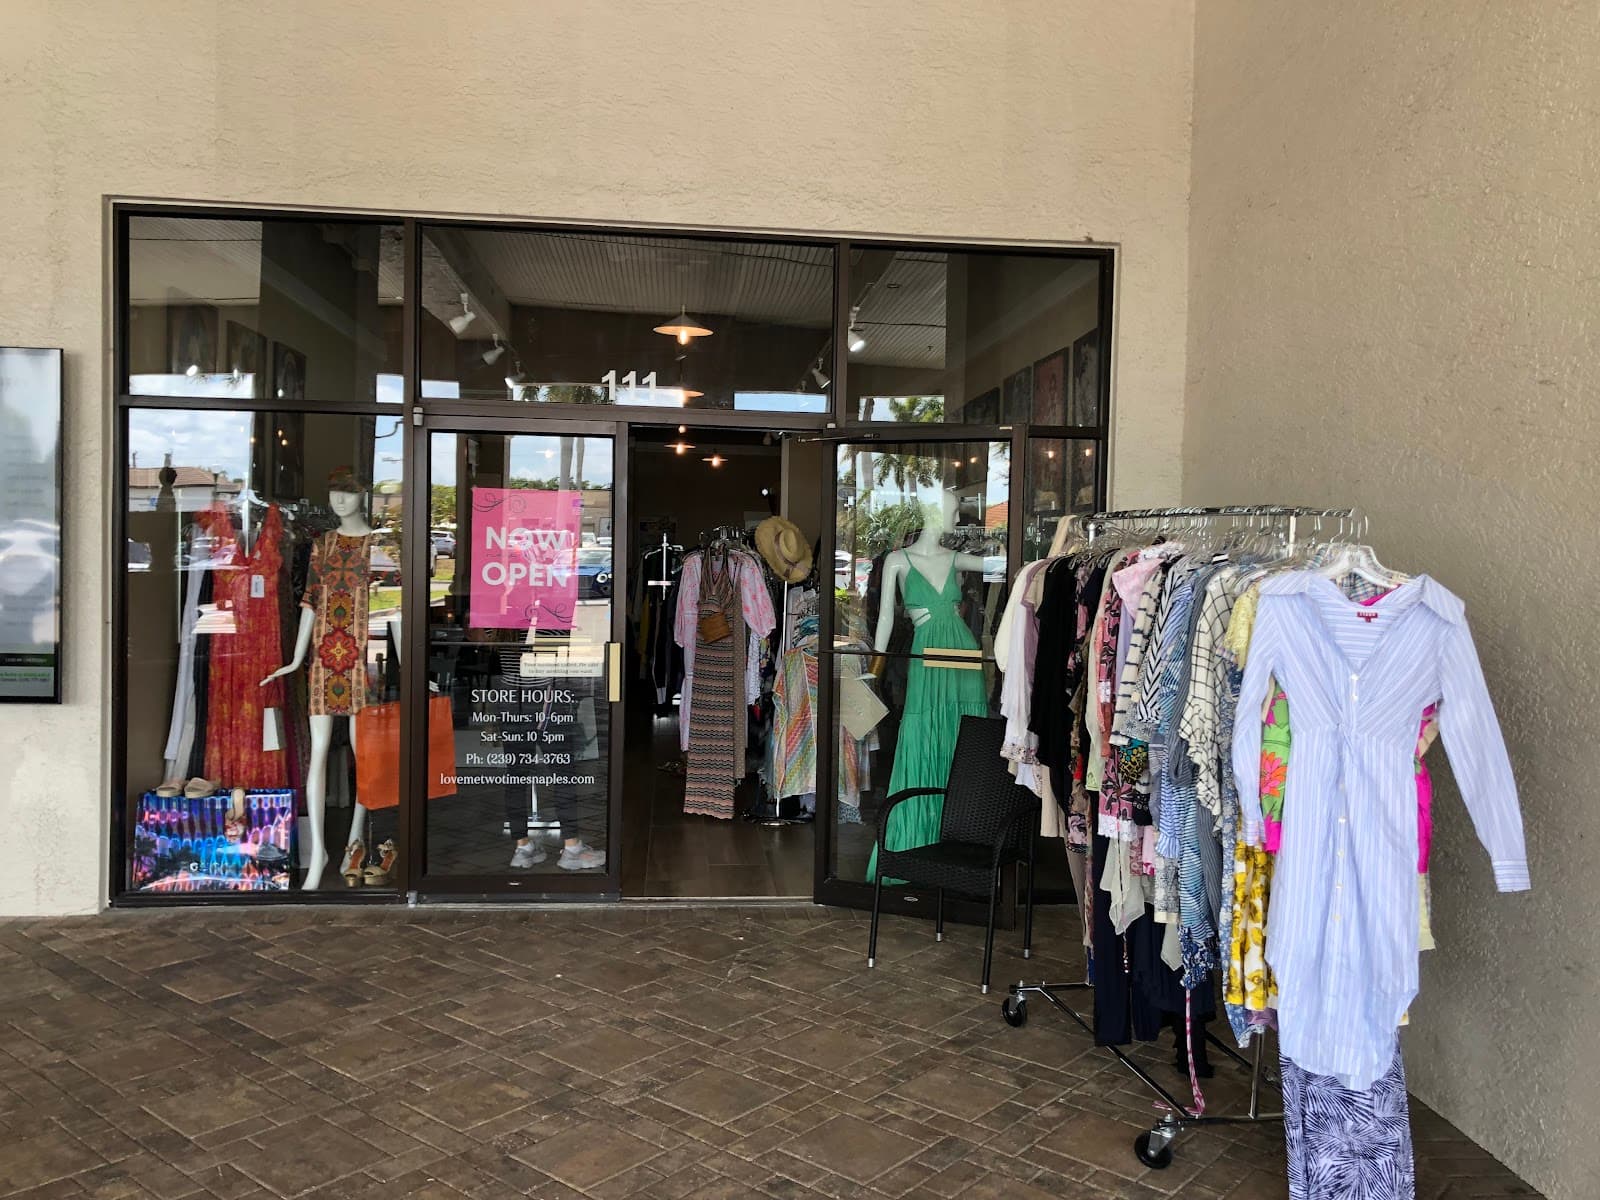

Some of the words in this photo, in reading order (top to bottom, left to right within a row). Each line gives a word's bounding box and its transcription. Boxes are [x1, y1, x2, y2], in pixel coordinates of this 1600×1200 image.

[601, 369, 657, 402] 111
[485, 526, 568, 551] NOW
[482, 561, 567, 587] OPEN
[471, 689, 518, 703] STORE
[521, 689, 575, 703] HOURS:
[472, 711, 532, 723] Mon-Thurs:
[480, 731, 524, 742] Sat-Sun:
[466, 753, 484, 765] Ph:
[486, 753, 516, 765] (239)
[518, 753, 571, 765] 734-3763
[440, 773, 595, 787] lovemetwotimesnaples.com
